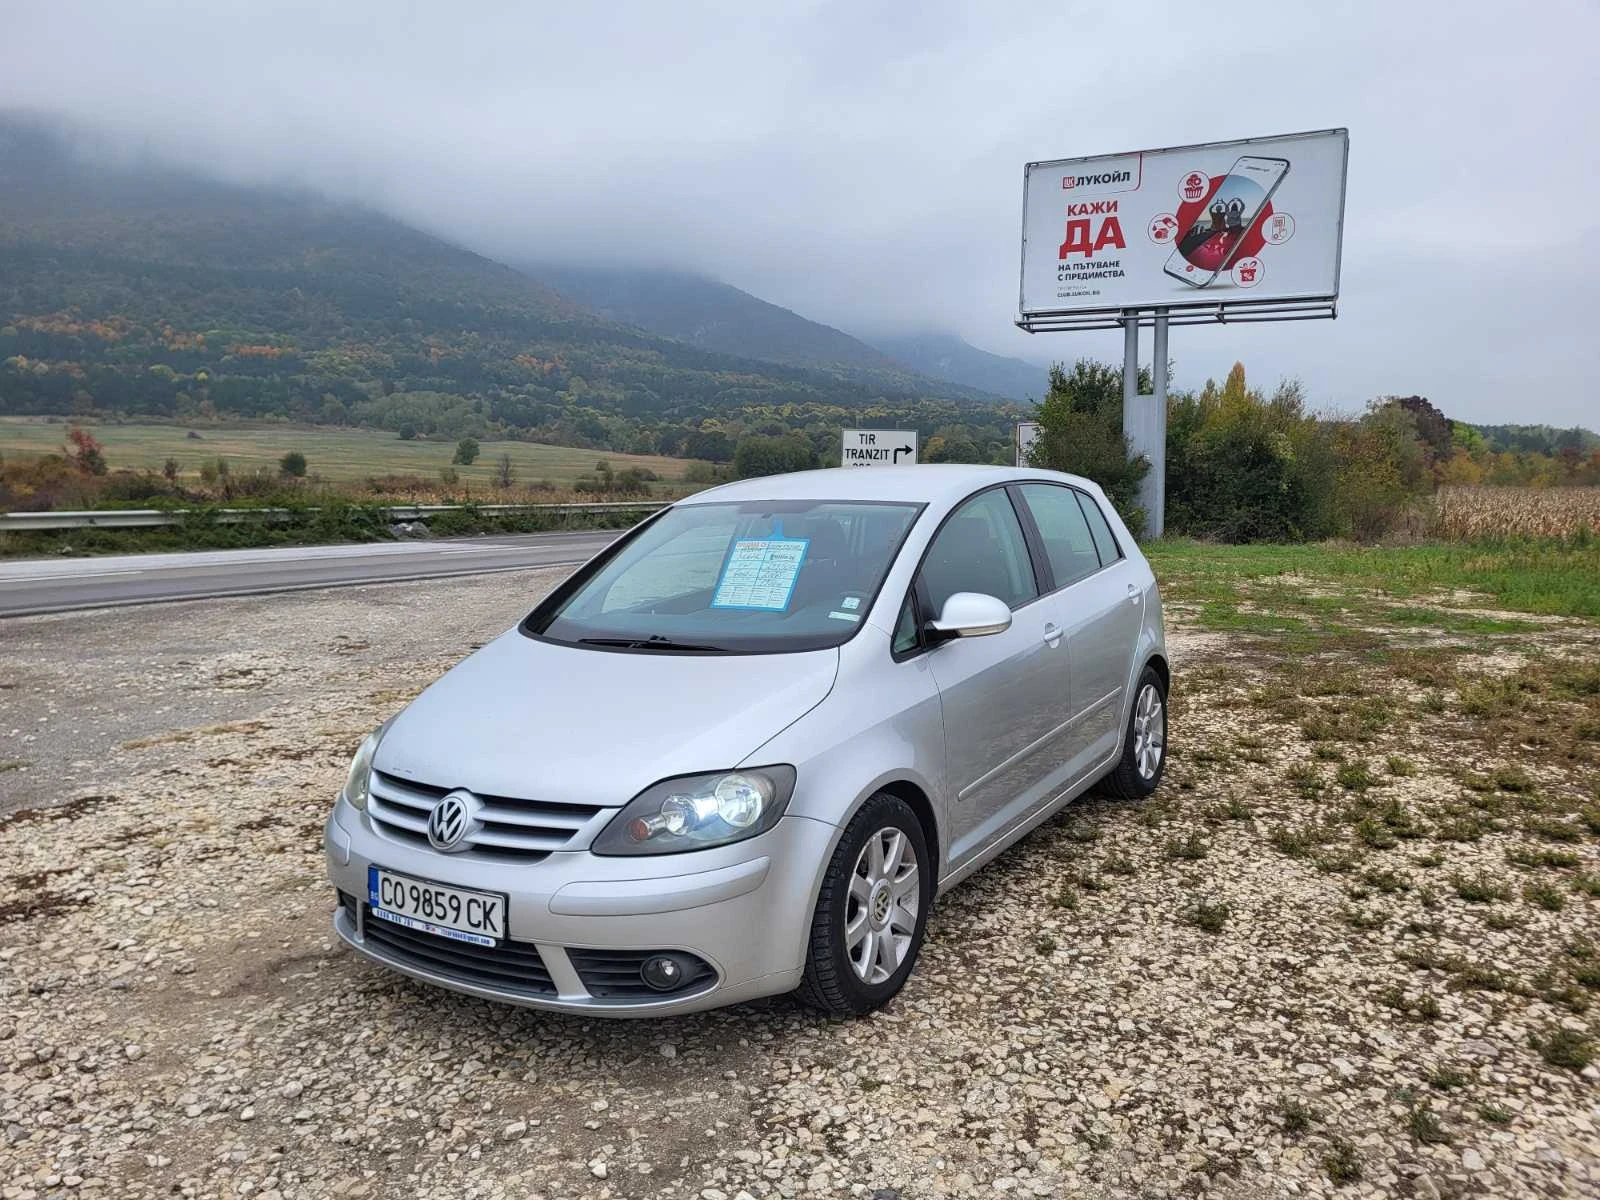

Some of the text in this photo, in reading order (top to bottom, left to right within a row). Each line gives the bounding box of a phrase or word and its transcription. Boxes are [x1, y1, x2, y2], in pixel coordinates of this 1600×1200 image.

[1075, 171, 1131, 187] ЛУКОЙЛ
[1067, 200, 1118, 216] КАЖИ
[1059, 216, 1126, 259] ДА
[1058, 260, 1121, 272] НА ПЪТУВАНЕ
[1057, 269, 1125, 281] С ПРЕДИМСТВА
[859, 433, 876, 445] TIR
[845, 448, 890, 460] TRANZIT
[409, 885, 461, 924] 9859
